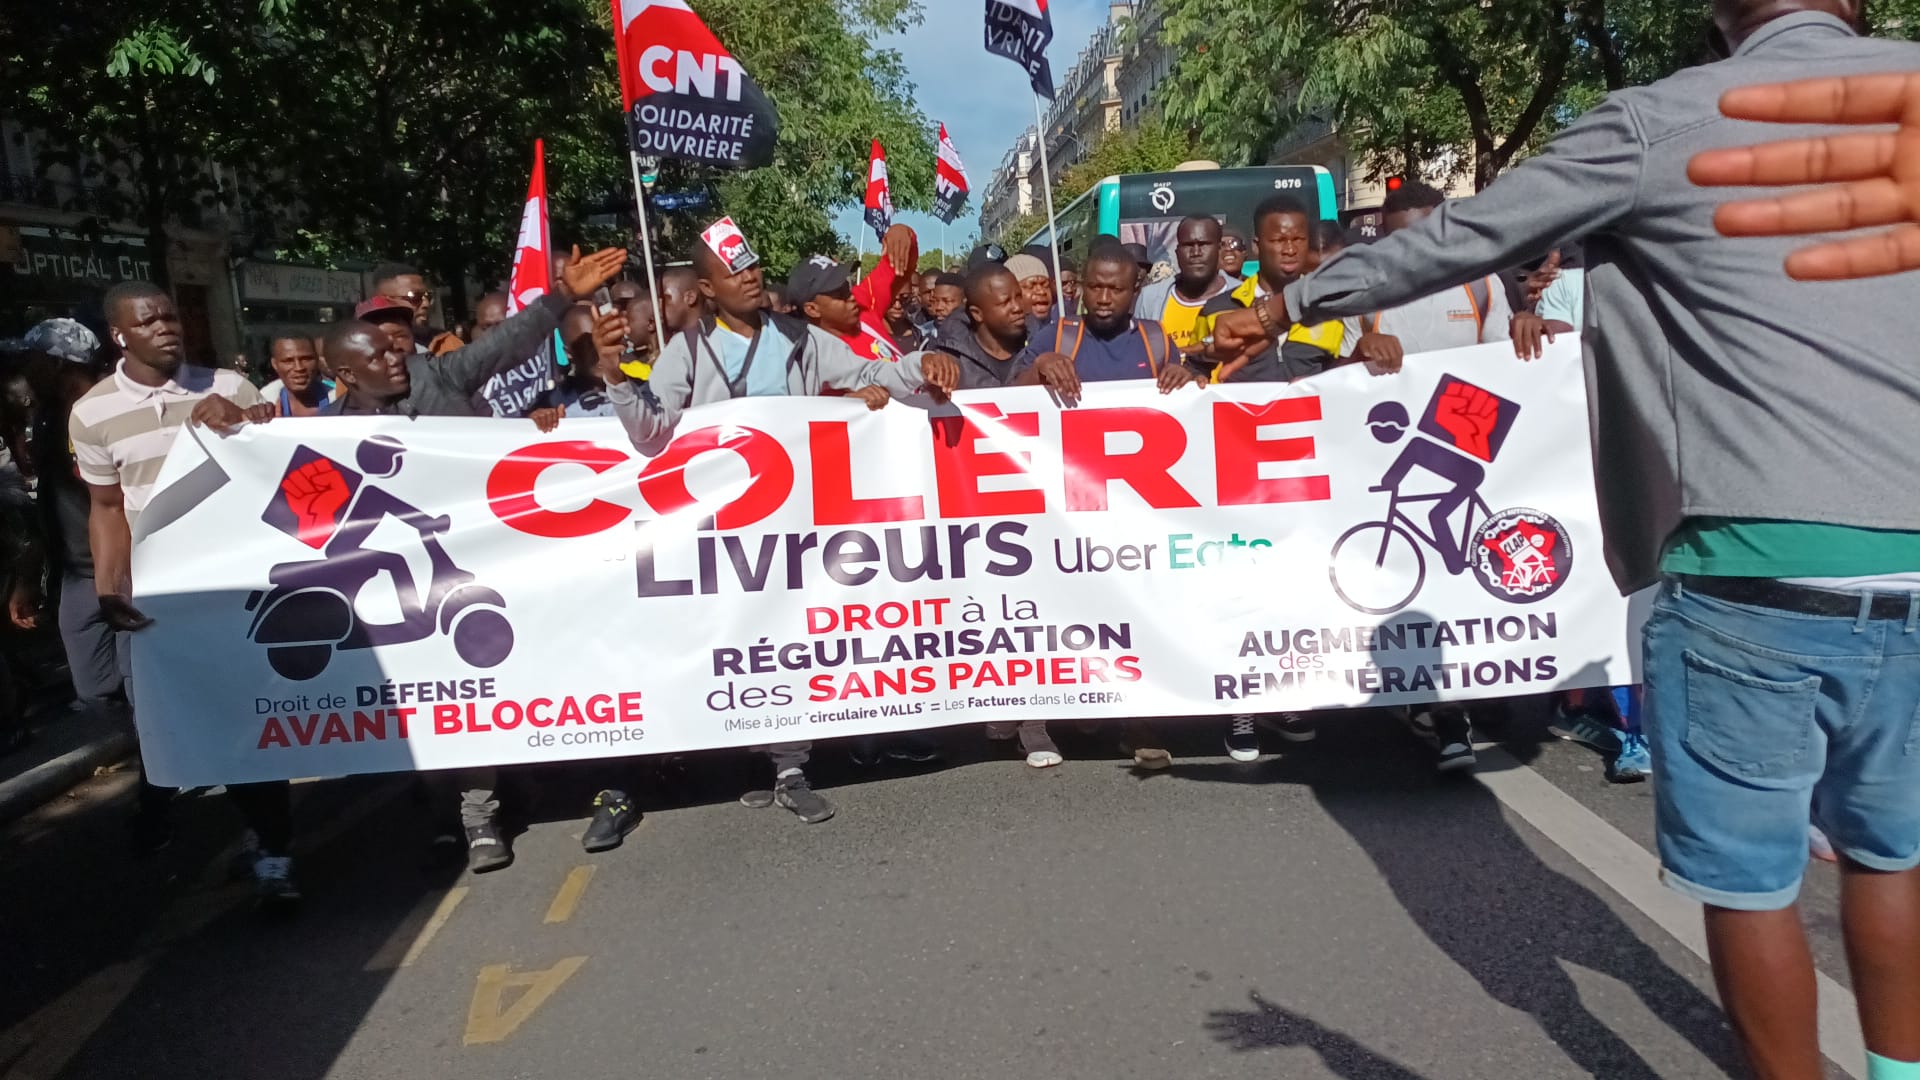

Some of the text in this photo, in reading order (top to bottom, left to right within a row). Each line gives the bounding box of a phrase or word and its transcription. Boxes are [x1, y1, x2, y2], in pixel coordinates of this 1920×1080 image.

[639, 45, 748, 102] CNT
[634, 104, 754, 138] SOLIDARITÉ
[638, 129, 743, 161] OUVRIÈRE
[1274, 178, 1301, 190] 3676
[486, 396, 1331, 538] COLÈRE
[634, 515, 1032, 598] Livreurs
[1054, 536, 1157, 574] Uber
[1503, 533, 1525, 555] CLAP
[806, 594, 1039, 635] DROIT à la
[1238, 612, 1557, 658] AUGMENTATION
[712, 623, 1131, 677] RÉGULARISATION
[1279, 651, 1324, 670] des
[255, 677, 497, 716] Droit de DÉFENSE
[706, 654, 1142, 712] des SANS PAPIERS
[1214, 655, 1558, 700] RÉMÉRATIONS
[257, 691, 644, 750] AVANT BLOCAGE
[724, 718, 761, 732] (Mise
[764, 714, 773, 727] à
[774, 714, 802, 730] jour
[945, 698, 965, 711] Les
[968, 694, 1026, 709] Factures
[1029, 693, 1060, 706] dans
[1064, 692, 1076, 704] le
[527, 724, 644, 749] de compte
